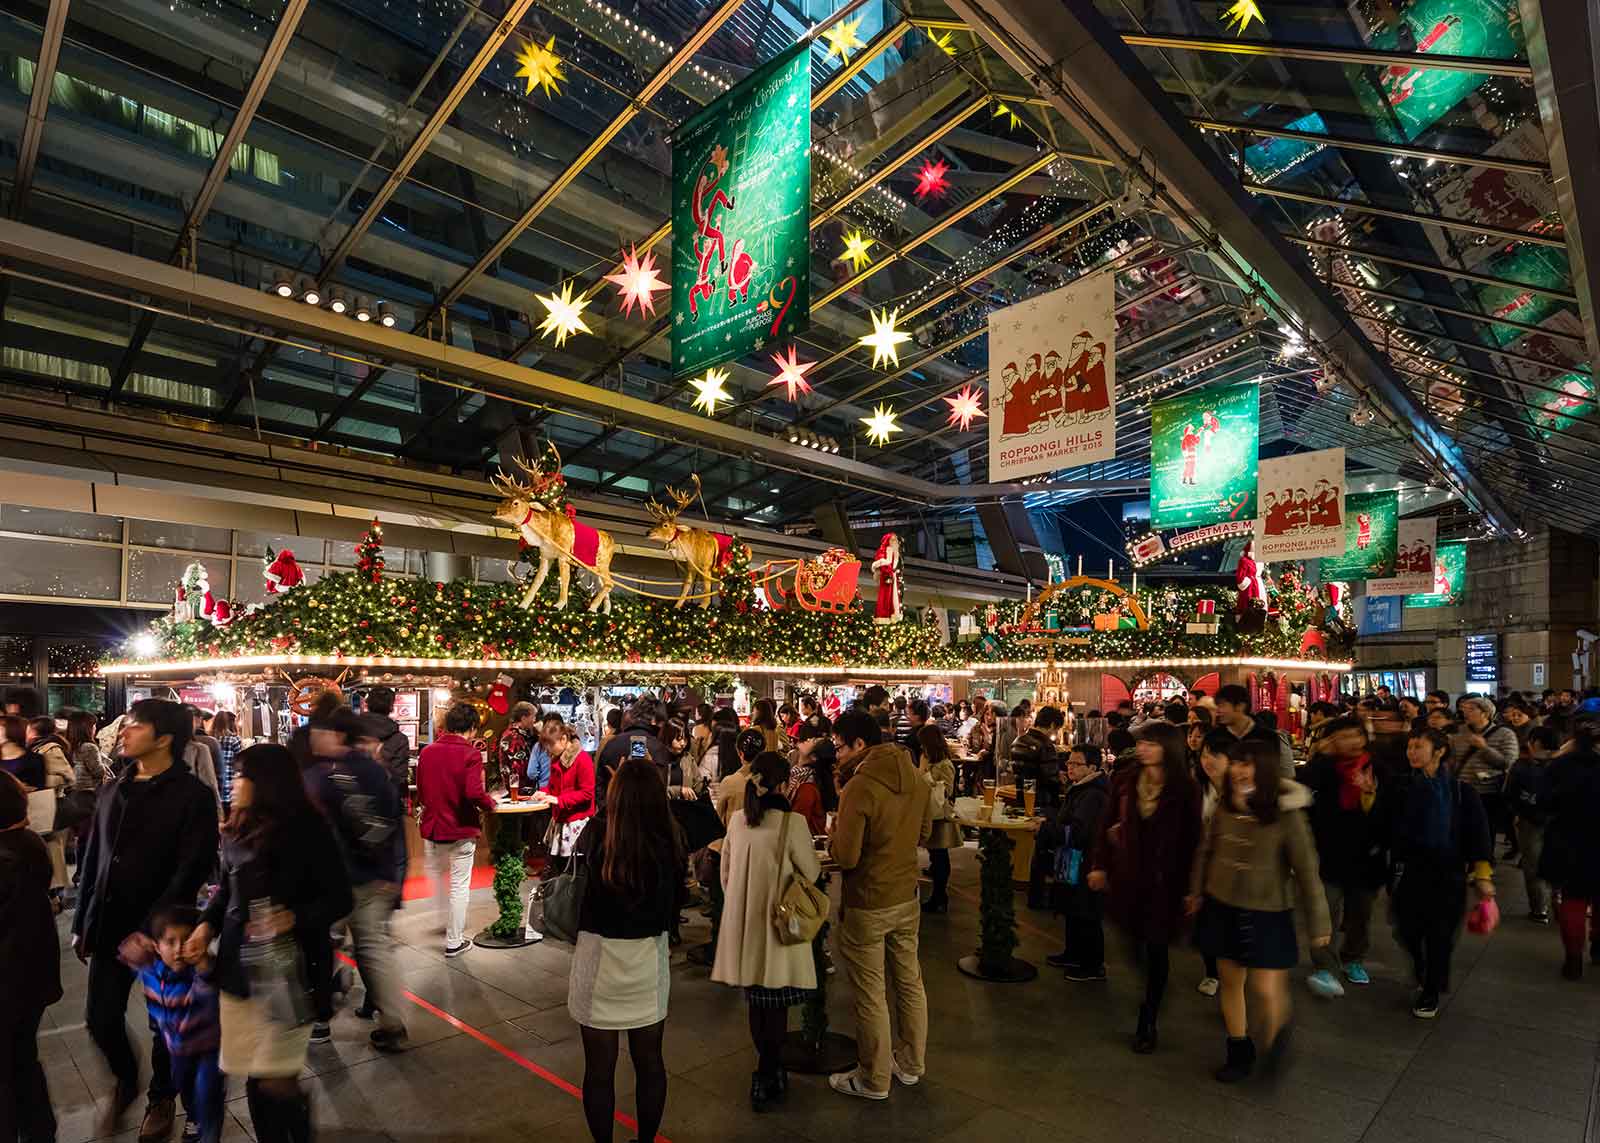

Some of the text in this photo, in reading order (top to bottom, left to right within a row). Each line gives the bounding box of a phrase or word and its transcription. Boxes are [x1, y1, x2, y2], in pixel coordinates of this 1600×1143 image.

[1000, 430, 1103, 461] ROPPONGI HILLS
[1000, 441, 1103, 468] CHRISTMAS MARKET 2015
[1171, 522, 1238, 546] CHRISTMAS
[1242, 520, 1254, 530] M
[1262, 537, 1336, 551] ROPPONGI HILLS
